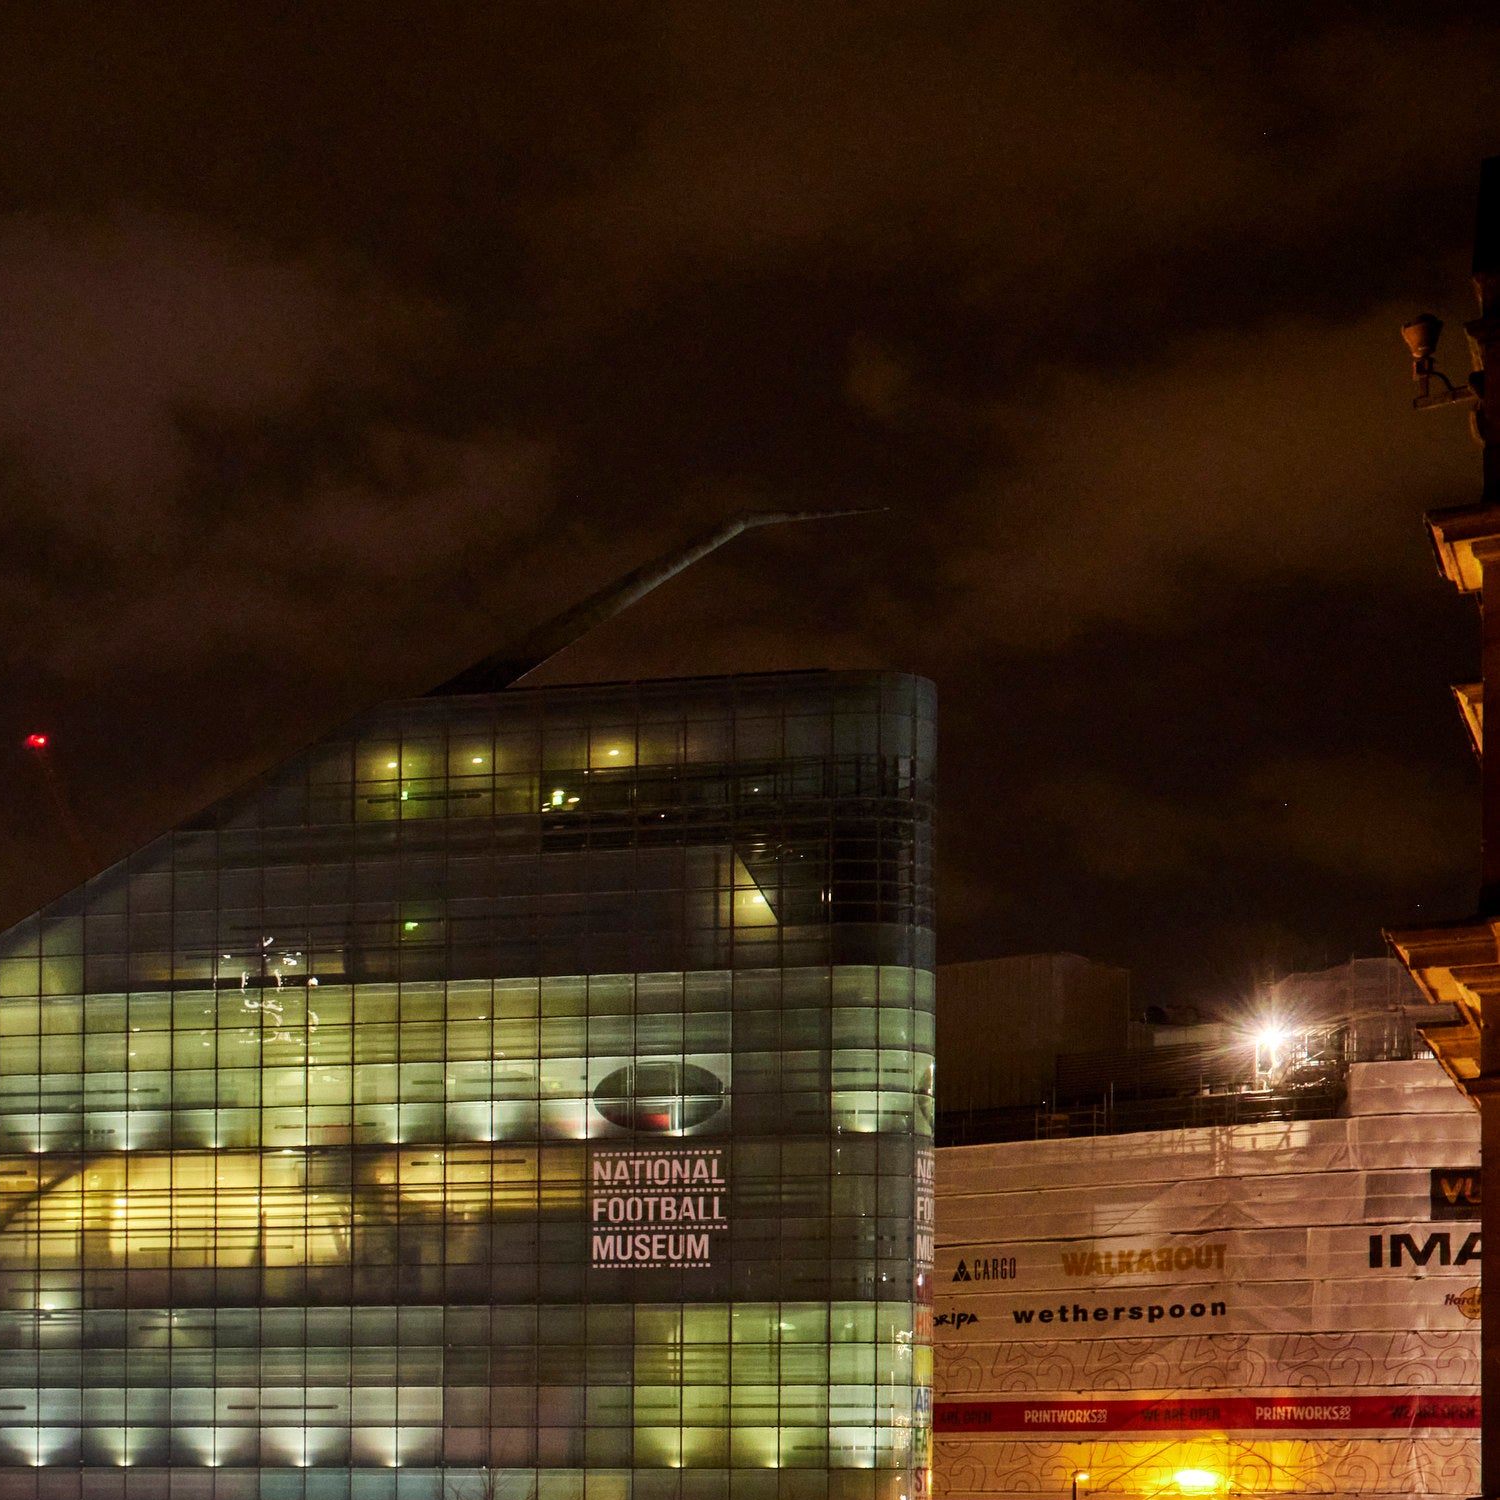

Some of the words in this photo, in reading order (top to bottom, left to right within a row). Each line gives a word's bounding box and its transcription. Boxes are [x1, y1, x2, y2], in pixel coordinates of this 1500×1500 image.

[593, 1158, 726, 1186] NATIONAL
[592, 1196, 727, 1223] FOOTBALL
[592, 1233, 710, 1261] MUSEUM
[974, 1257, 1017, 1281] CARGO
[1061, 1243, 1227, 1277] WALKABOUT
[1013, 1301, 1227, 1325] wetherspoon
[1164, 1408, 1185, 1422] ARE
[1190, 1407, 1220, 1421] OPEN
[1417, 1405, 1439, 1420] ARE
[1444, 1405, 1475, 1420] OPEN
